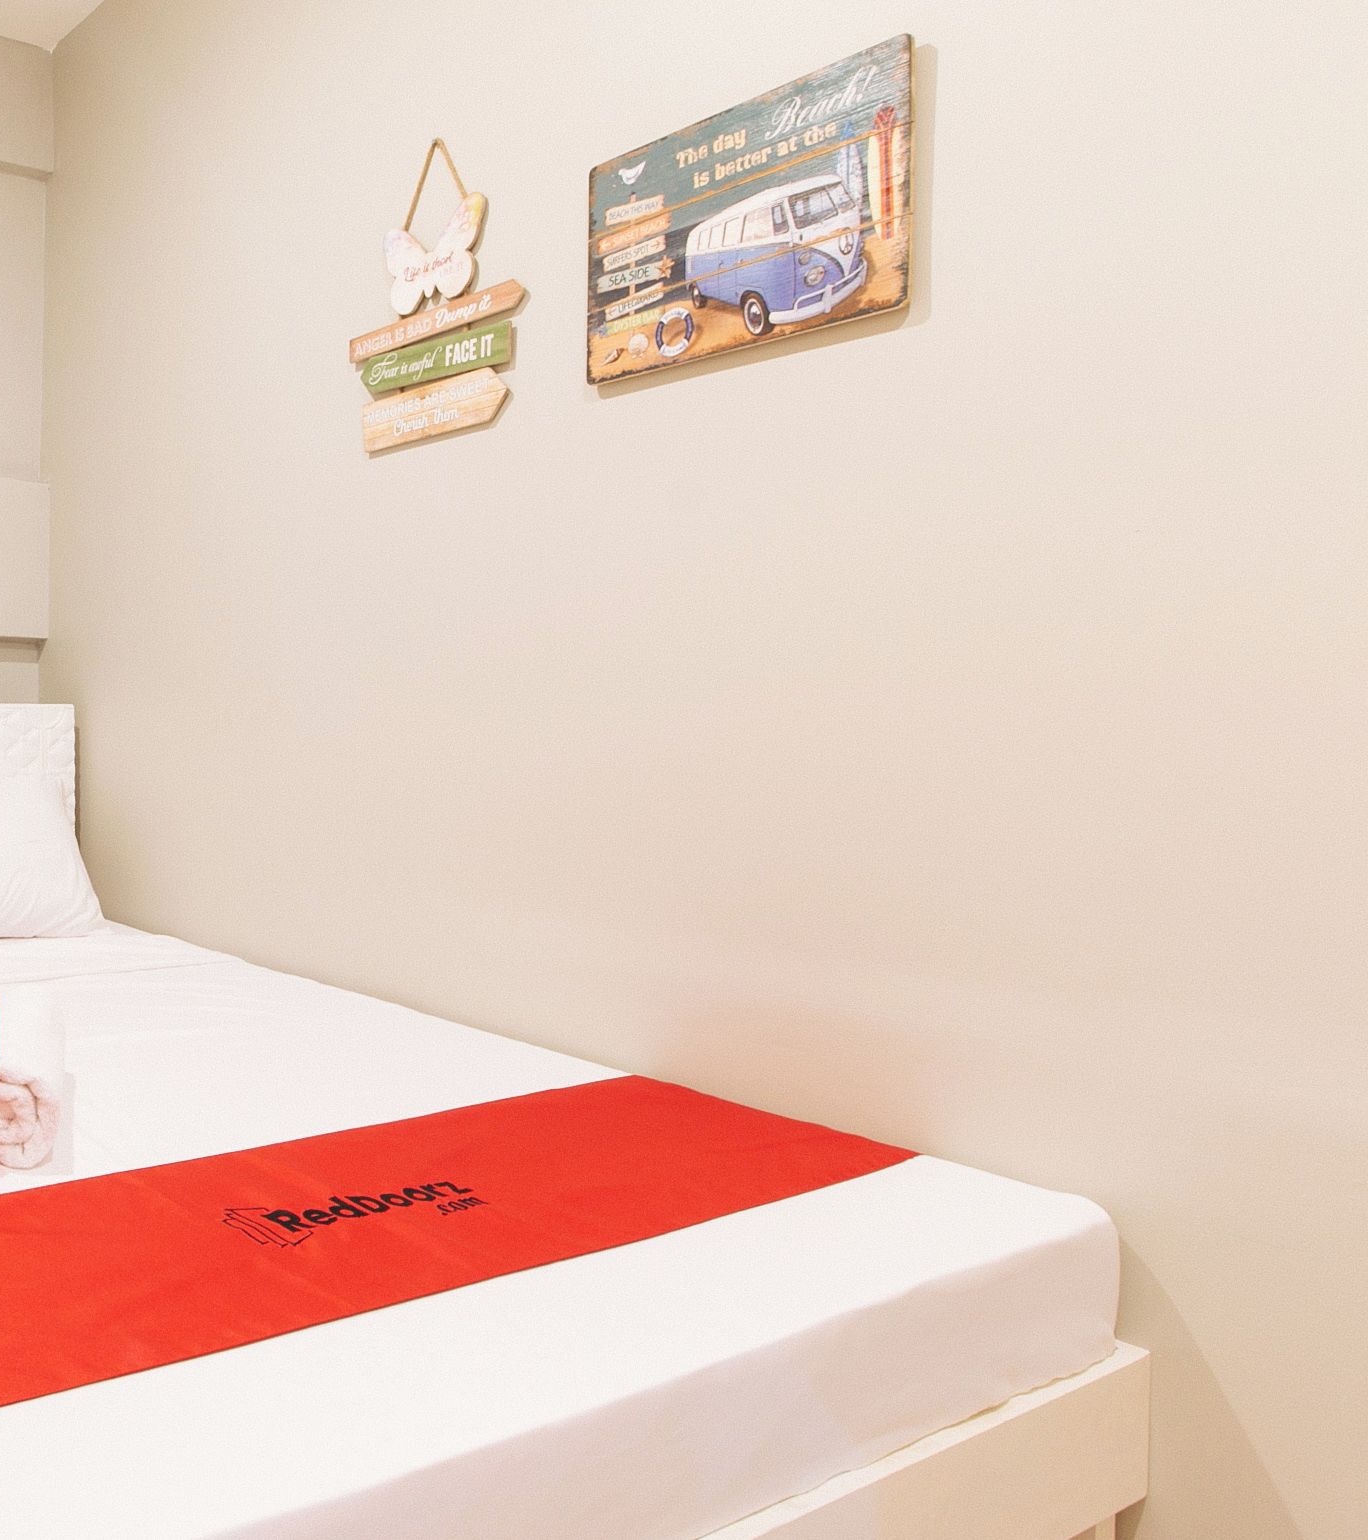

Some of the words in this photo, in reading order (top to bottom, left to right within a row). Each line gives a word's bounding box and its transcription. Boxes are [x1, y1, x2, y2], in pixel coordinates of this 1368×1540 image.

[675, 143, 709, 169] The
[712, 128, 747, 154] day
[693, 169, 710, 189] is
[714, 146, 772, 181] better
[776, 135, 799, 157] at
[803, 121, 838, 147] the
[608, 273, 627, 287] SEA
[628, 266, 650, 281] SIDE
[445, 336, 478, 366] FACE
[480, 333, 495, 358] IT
[260, 1181, 474, 1234] RedDoorz
[433, 1194, 489, 1217] .com
